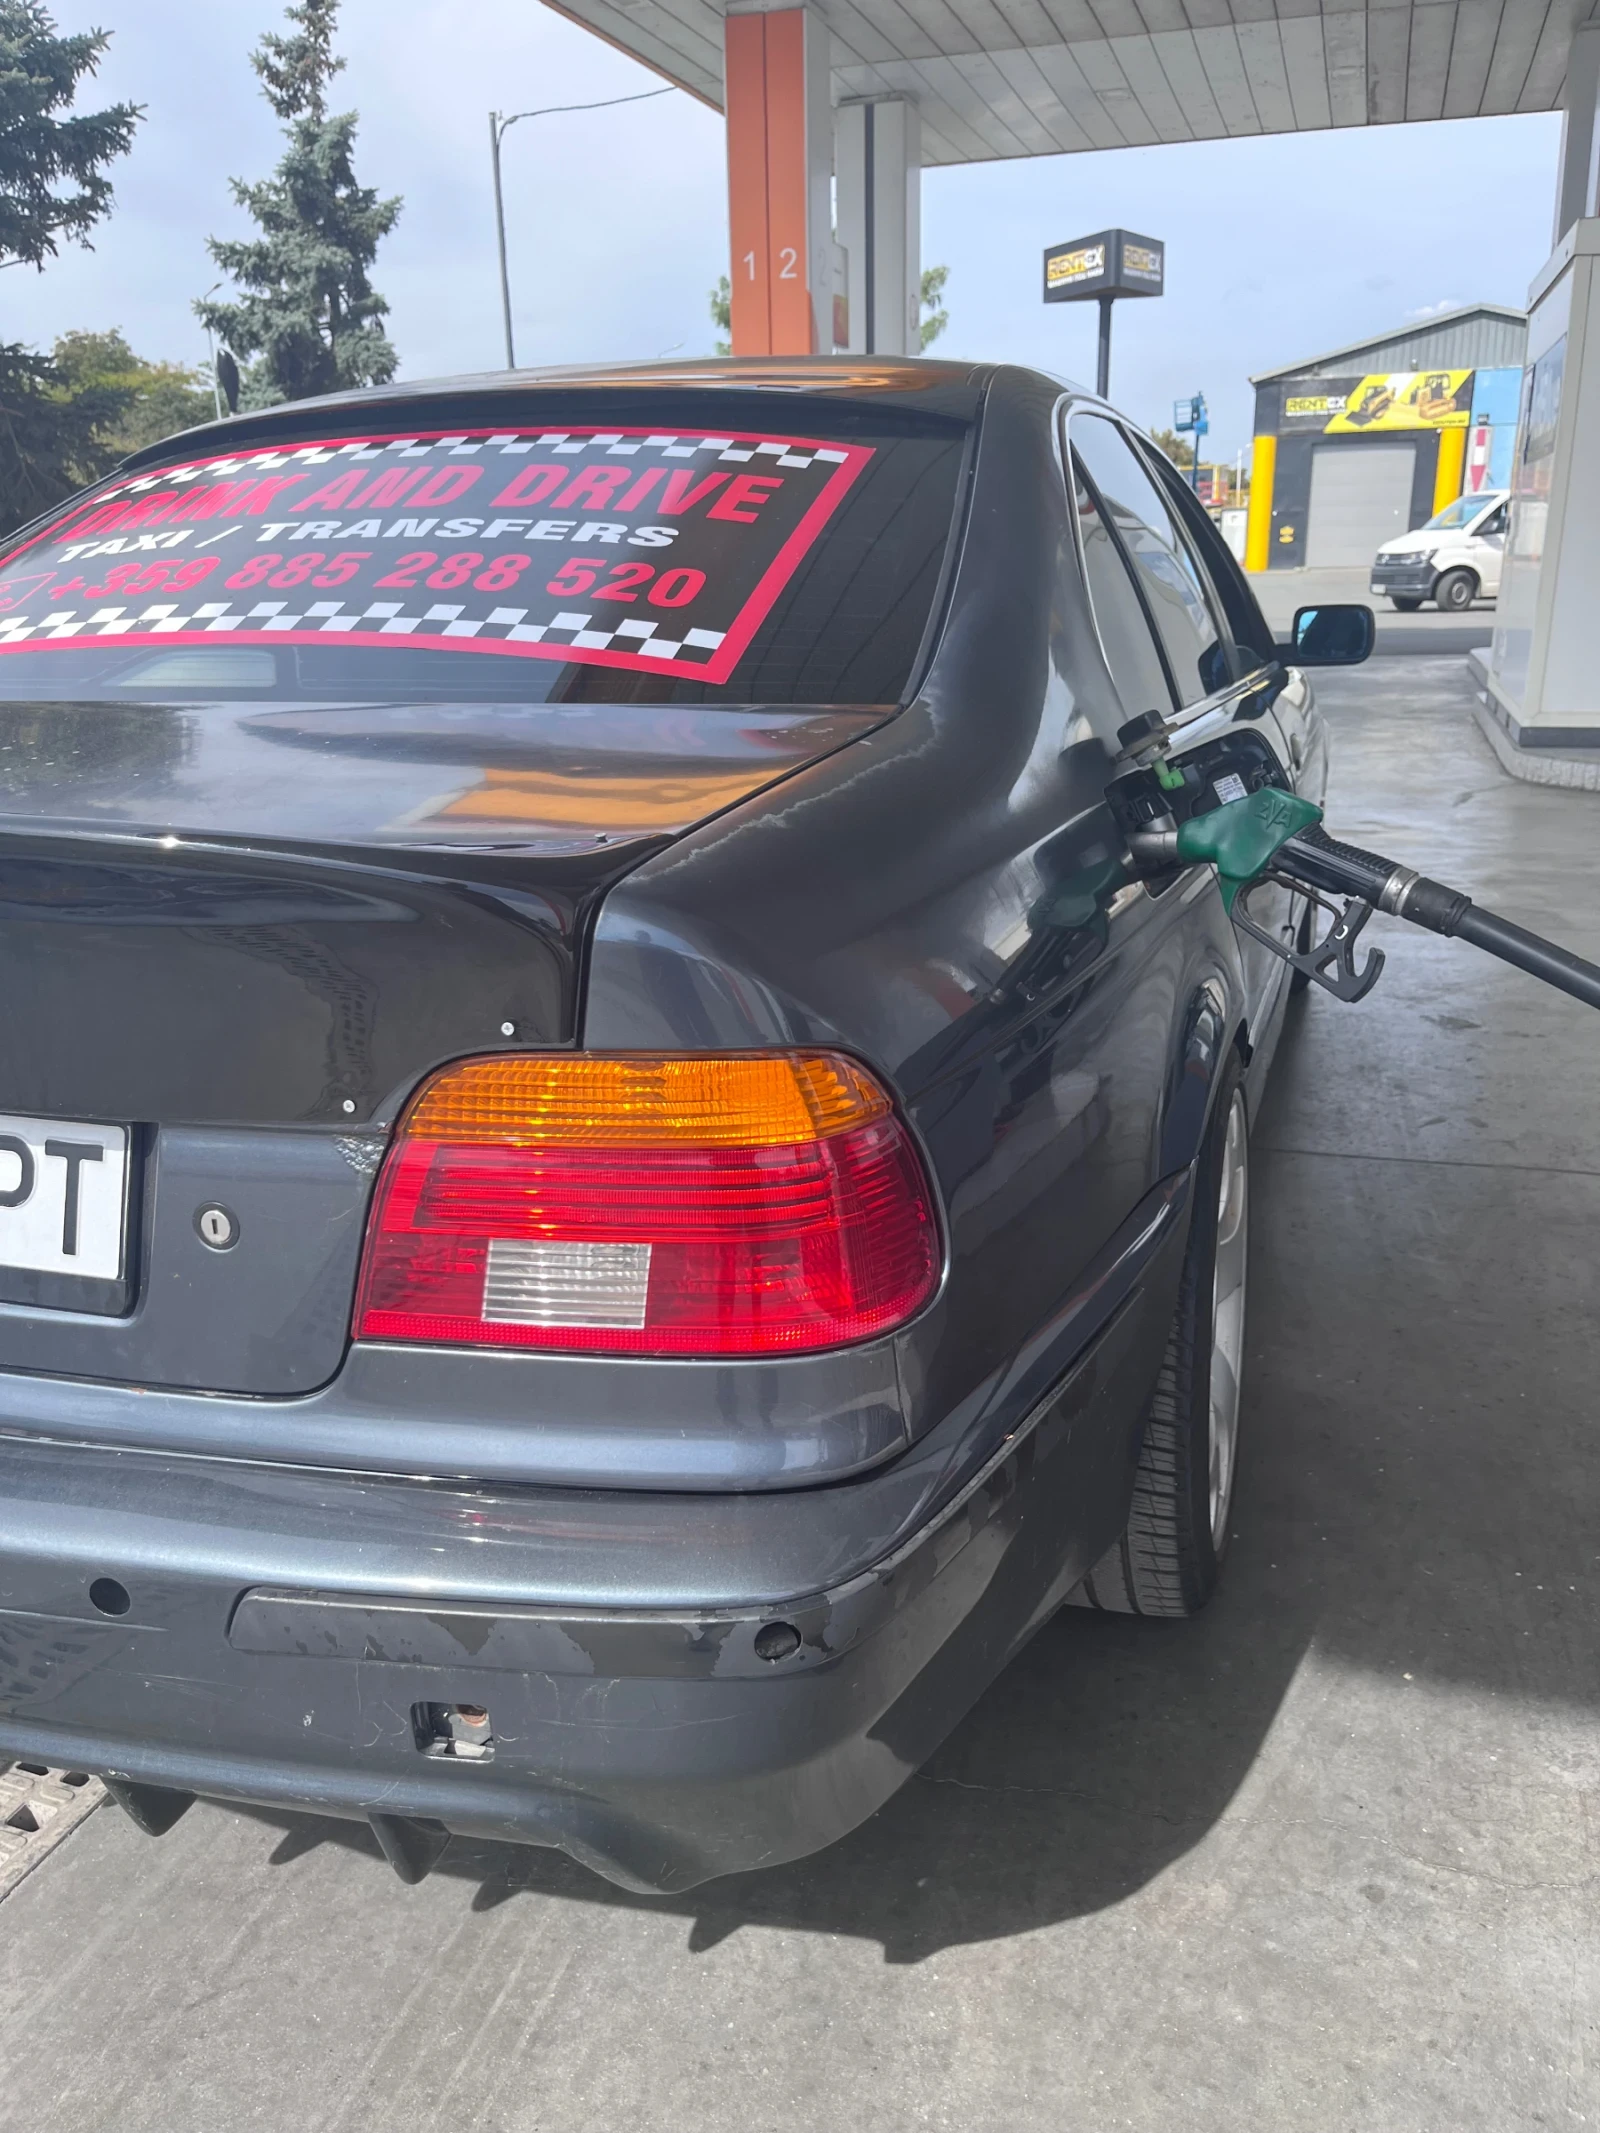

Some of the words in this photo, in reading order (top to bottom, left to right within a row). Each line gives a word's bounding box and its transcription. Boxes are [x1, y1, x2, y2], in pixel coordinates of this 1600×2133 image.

[743, 251, 756, 281] 1
[779, 247, 798, 279] 2
[52, 473, 311, 544] DRINK
[288, 465, 485, 512] AND
[489, 465, 785, 523] DRIVE
[57, 529, 194, 563] TAXI
[195, 525, 244, 548] /
[255, 518, 680, 547] TRANSFERS
[48, 556, 221, 600] +359
[224, 552, 373, 589] 885
[373, 551, 532, 592] 288
[545, 557, 707, 608] 520
